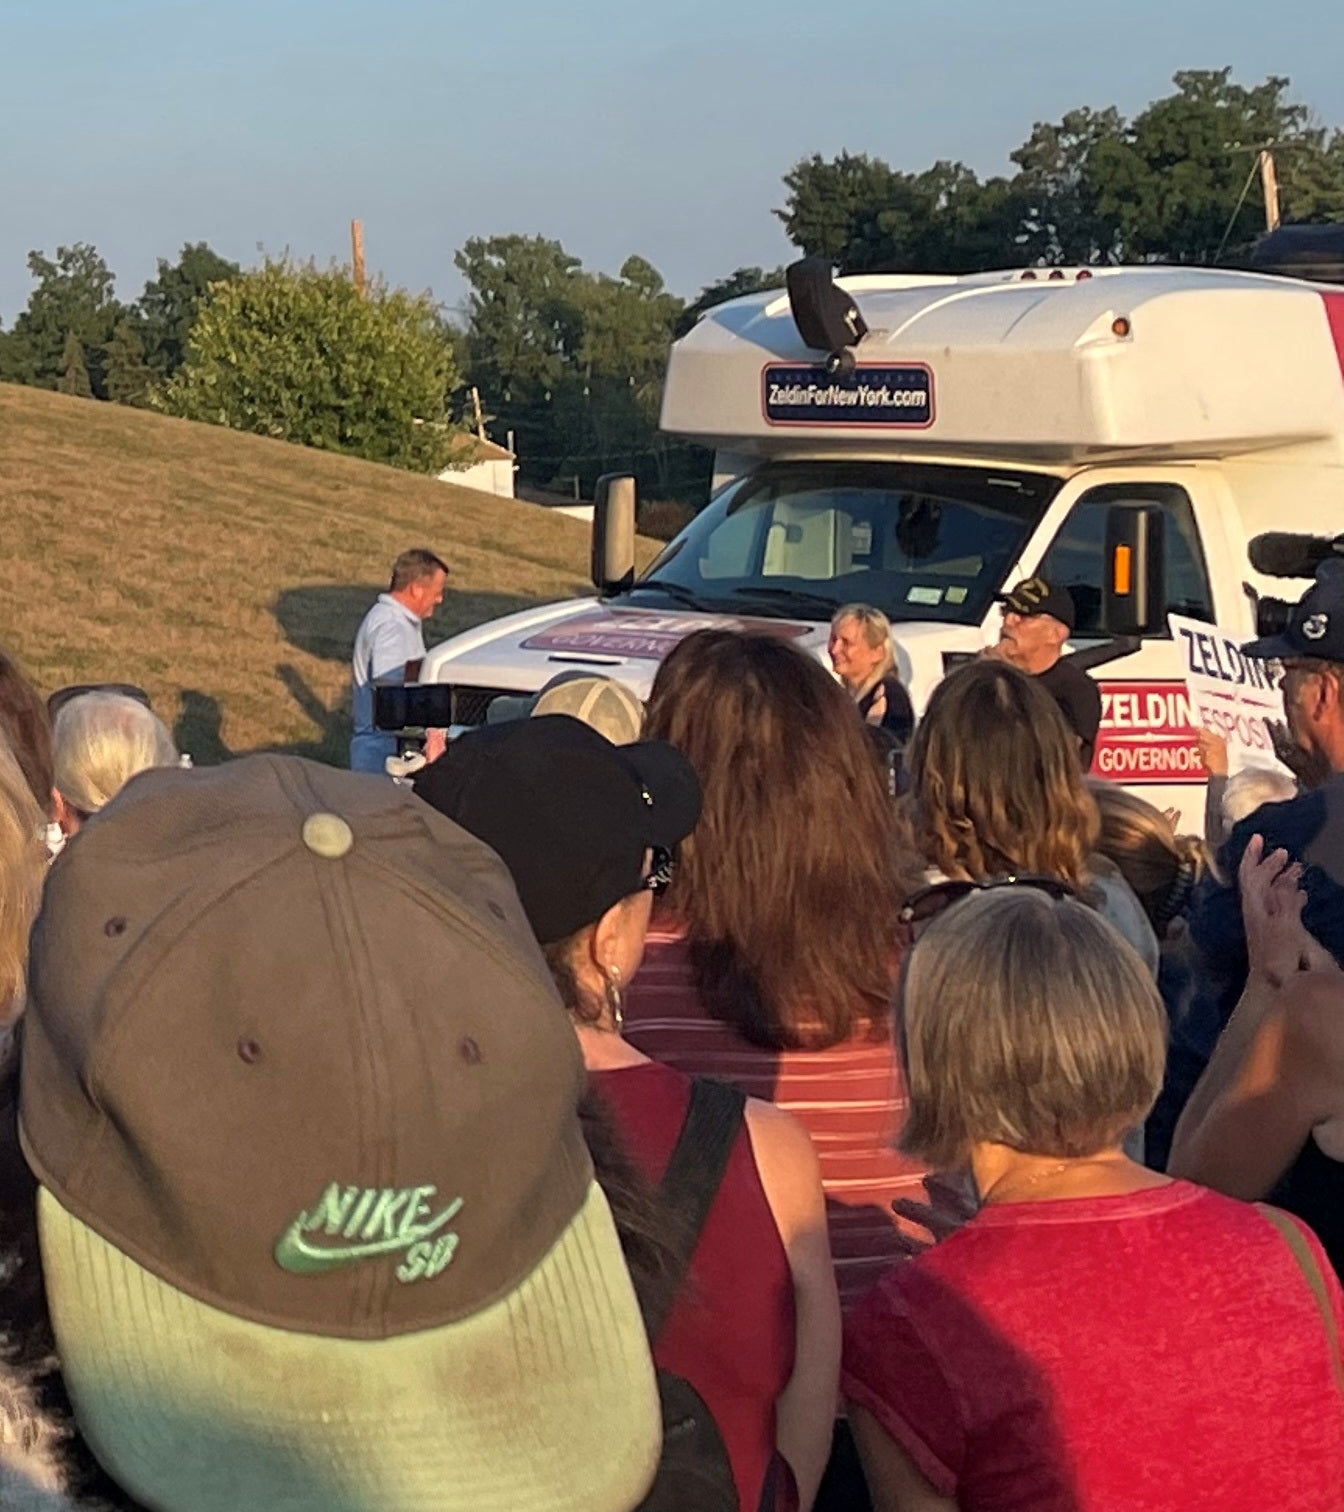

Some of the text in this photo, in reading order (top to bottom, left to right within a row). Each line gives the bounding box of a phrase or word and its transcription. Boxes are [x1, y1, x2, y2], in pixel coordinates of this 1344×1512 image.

[768, 384, 927, 407] ZeldinForNewYork.com
[1099, 693, 1197, 729] ZELDIN
[1098, 747, 1204, 772] GOVERNOR
[305, 1182, 437, 1239] NIKE
